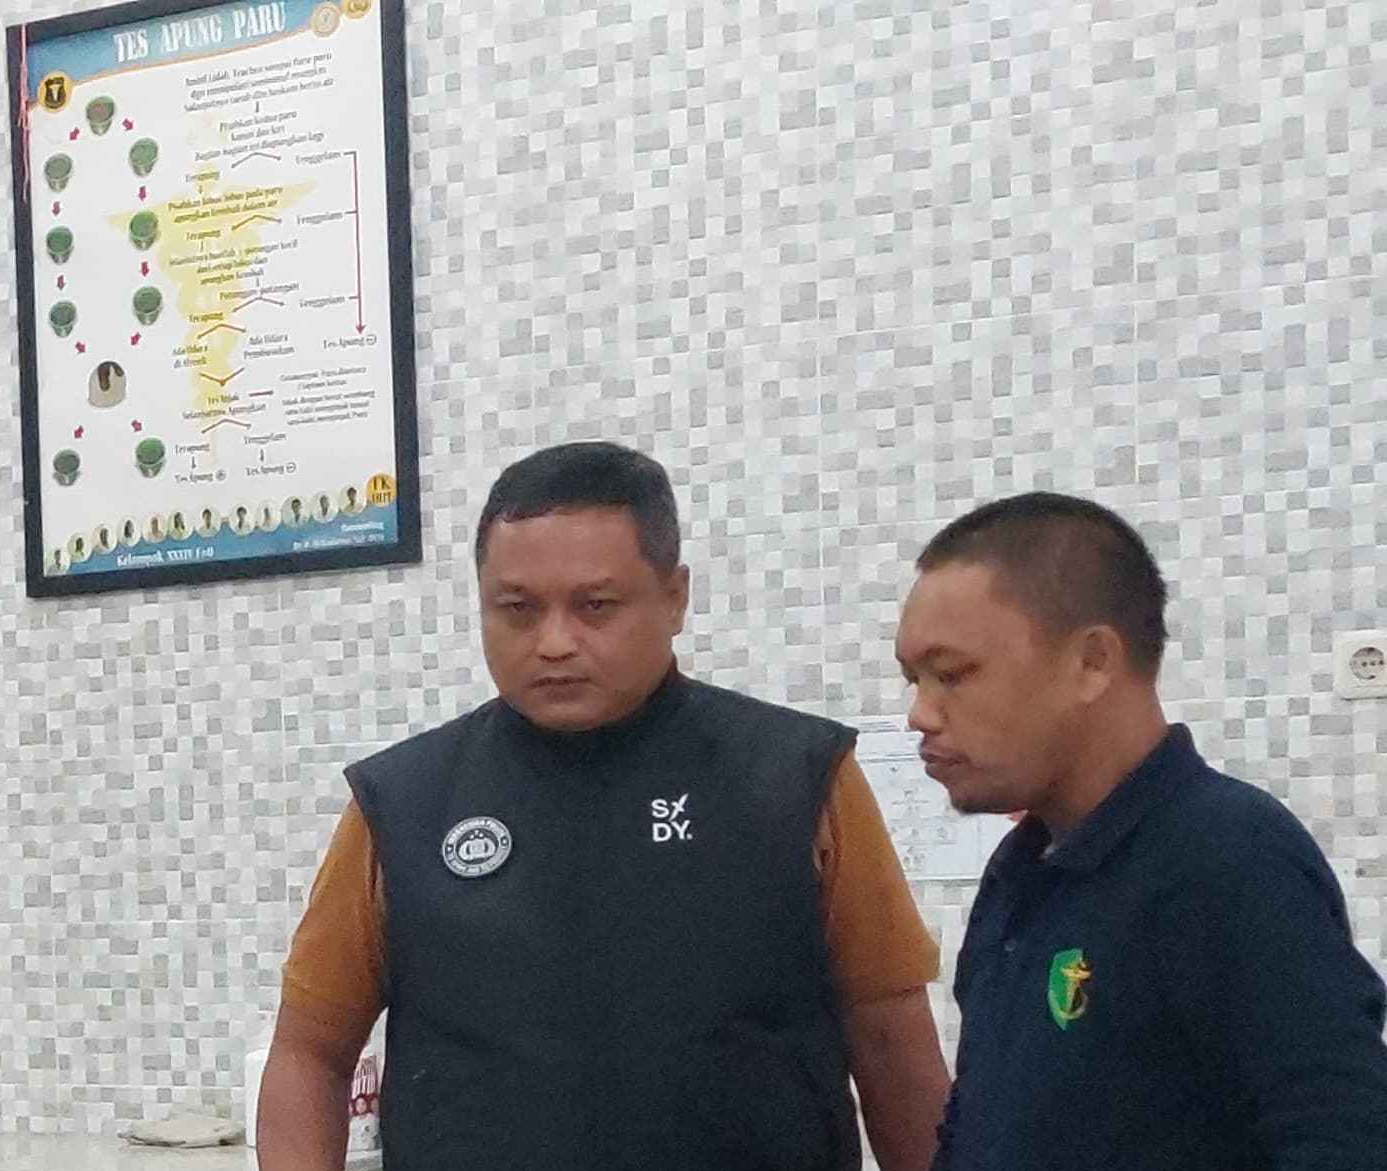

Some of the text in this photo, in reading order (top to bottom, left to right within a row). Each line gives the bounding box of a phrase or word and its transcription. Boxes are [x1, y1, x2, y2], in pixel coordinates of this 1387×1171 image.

[113, 1, 285, 62] TES APUNG PARU
